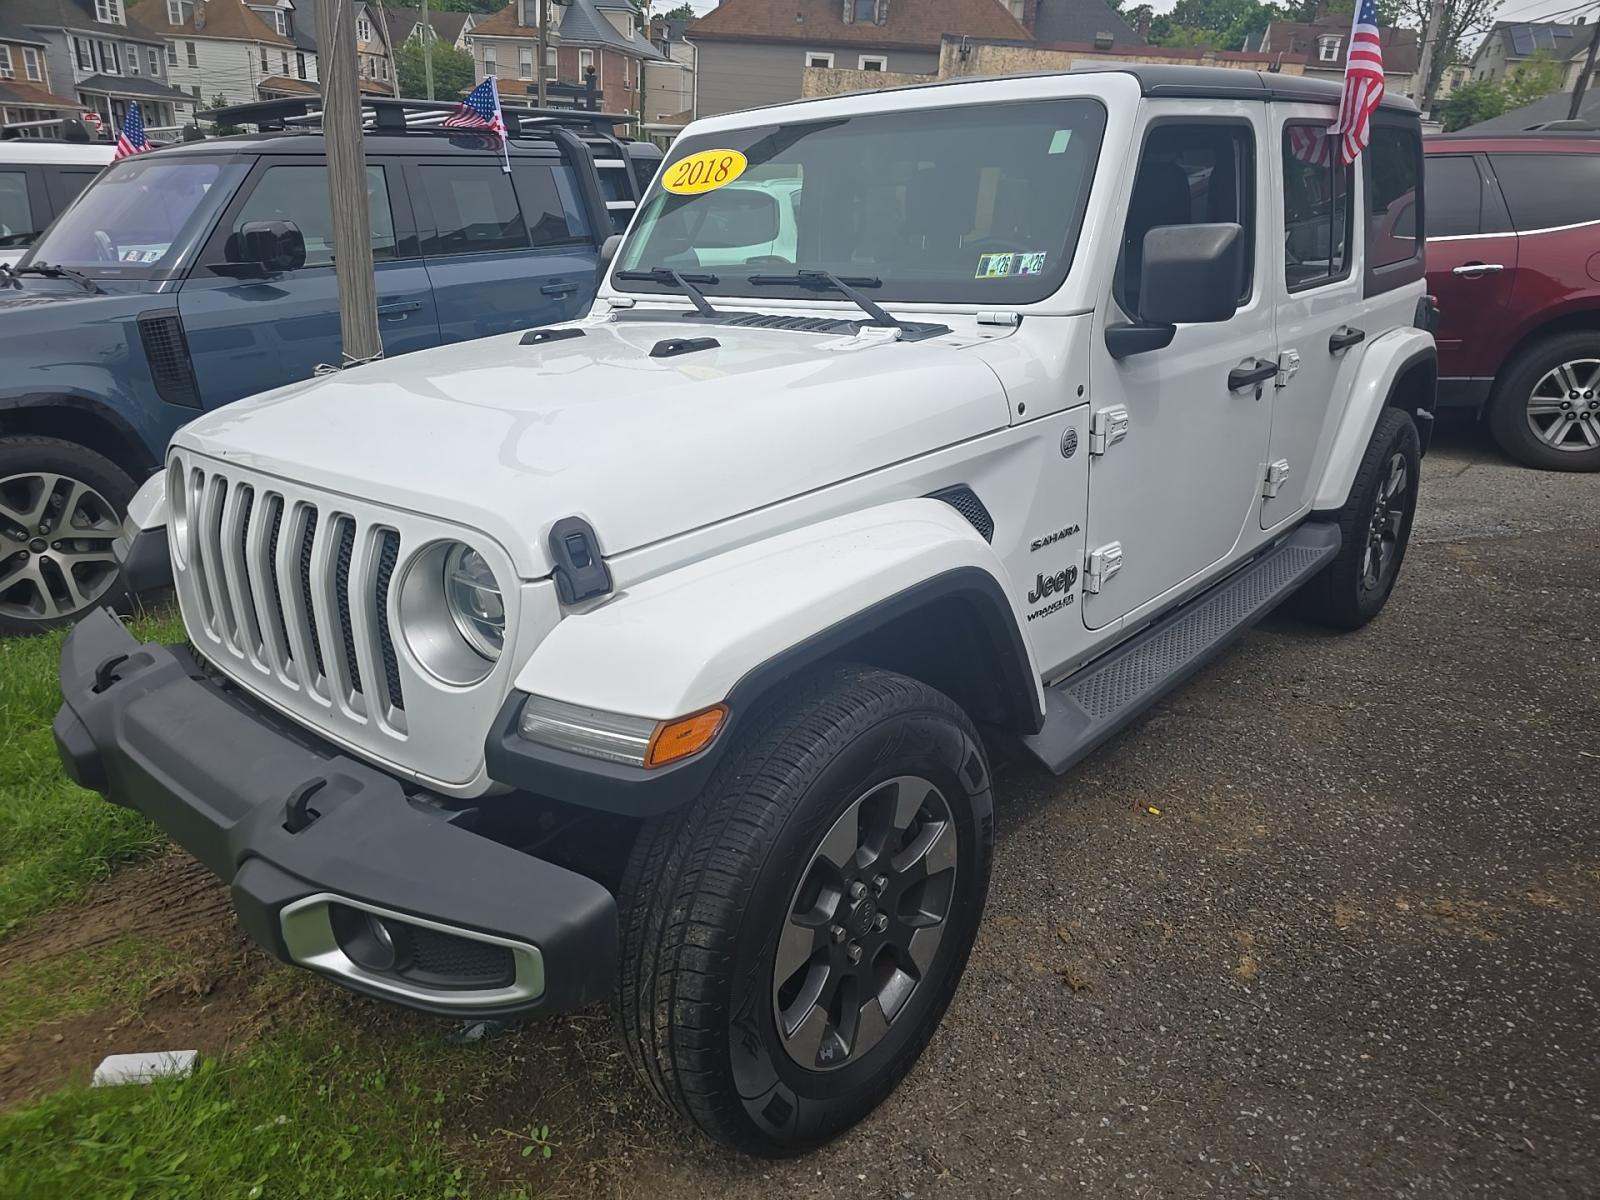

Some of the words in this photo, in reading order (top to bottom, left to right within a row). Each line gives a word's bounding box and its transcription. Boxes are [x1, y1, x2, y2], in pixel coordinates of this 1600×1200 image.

[672, 156, 733, 187] 2018
[1030, 524, 1080, 552] SAHARA
[1028, 564, 1078, 604] Jeep
[1027, 593, 1074, 622] WRANGLER
